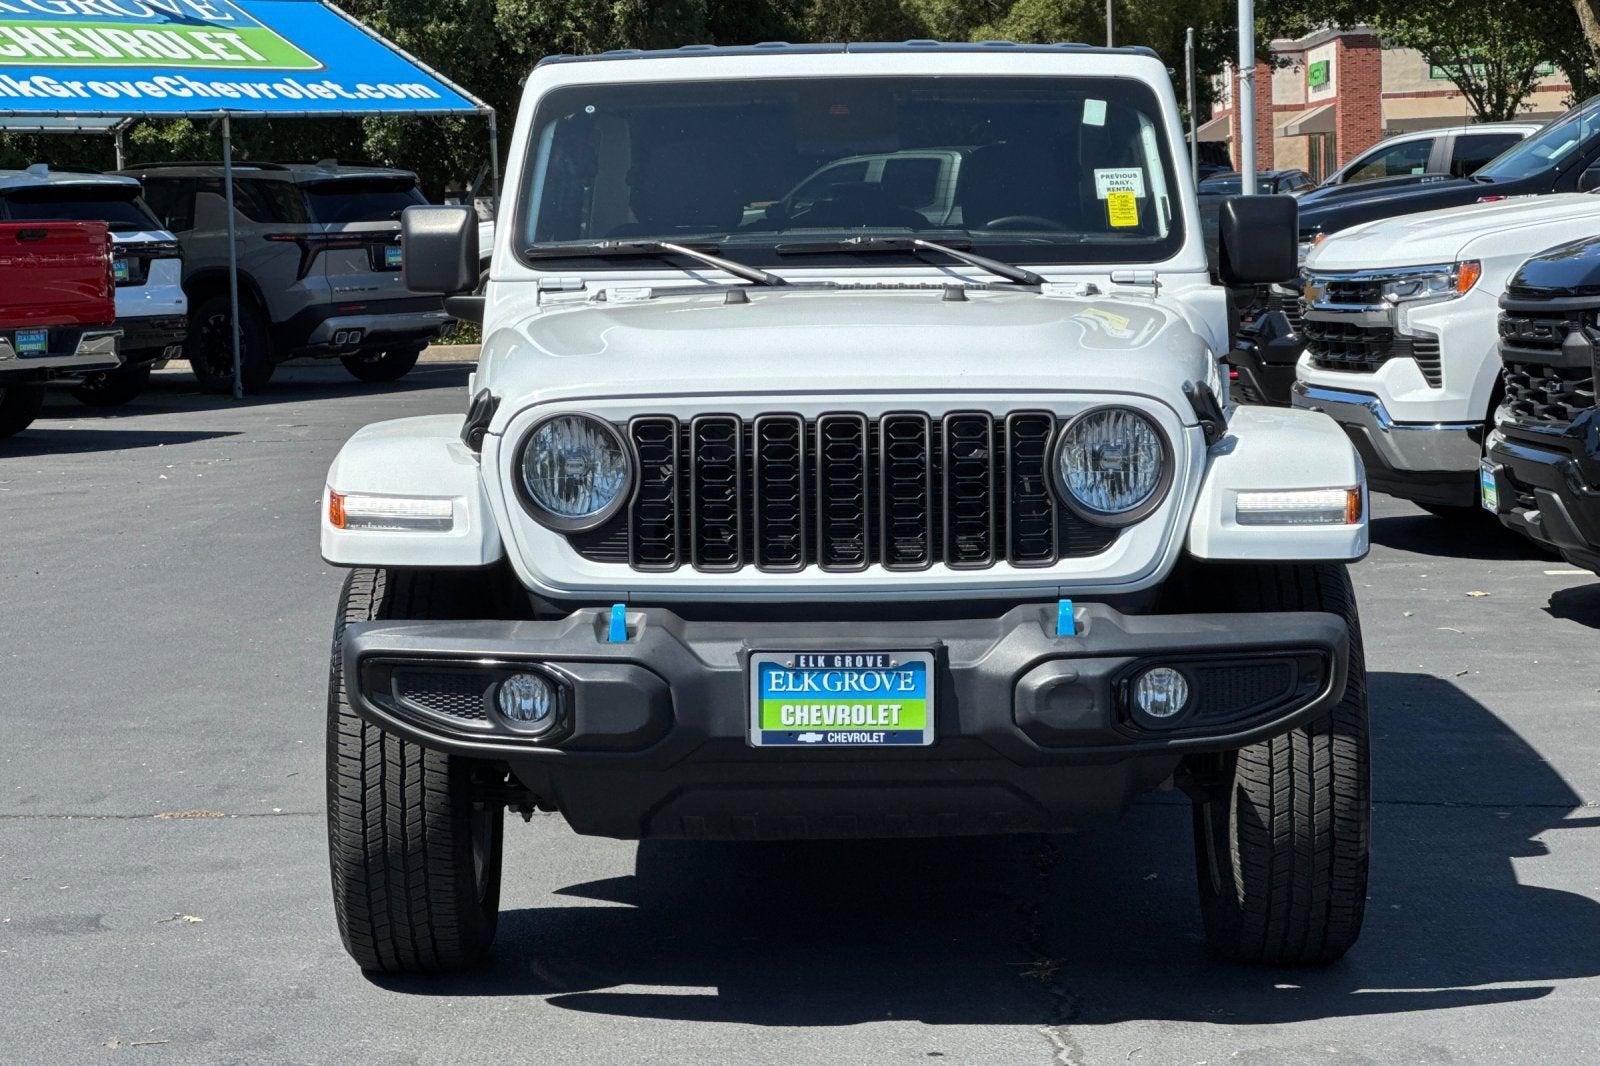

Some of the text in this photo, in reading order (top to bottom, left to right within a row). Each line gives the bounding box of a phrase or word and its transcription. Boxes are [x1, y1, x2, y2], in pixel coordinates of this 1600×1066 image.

[0, 74, 441, 99] lkGroveChevrolet.com
[800, 655, 883, 667] ELK GROVE
[781, 704, 902, 726] CHEVROLET
[827, 732, 885, 743] CHEVROLET
